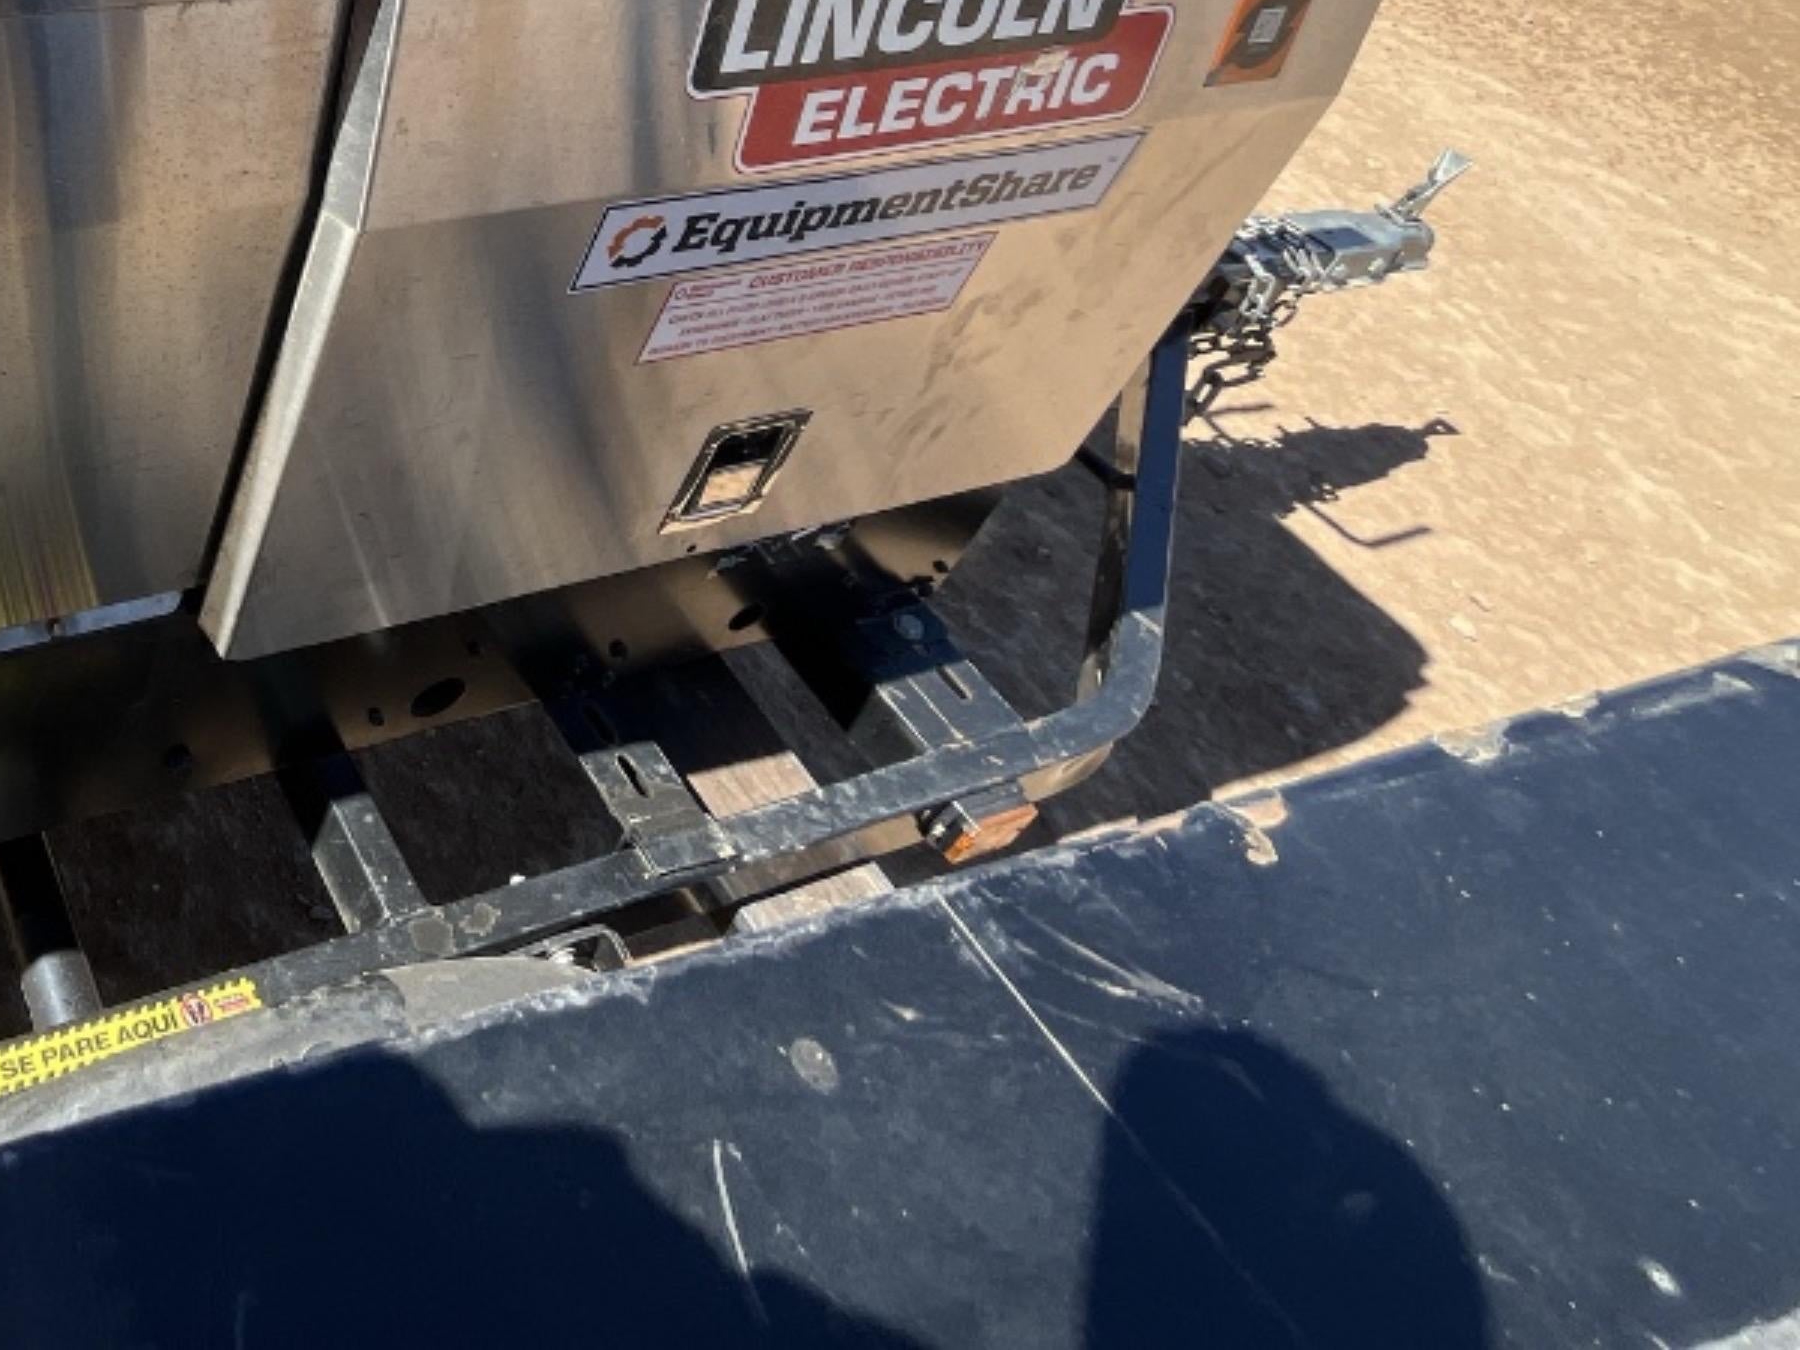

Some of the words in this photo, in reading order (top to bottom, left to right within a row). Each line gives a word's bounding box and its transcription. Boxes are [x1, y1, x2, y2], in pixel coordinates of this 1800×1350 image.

[791, 53, 1120, 147] ELECTRIC
[671, 163, 1102, 259] EquipmentShare
[0, 1053, 36, 1081] SE
[40, 1031, 113, 1067] PARE
